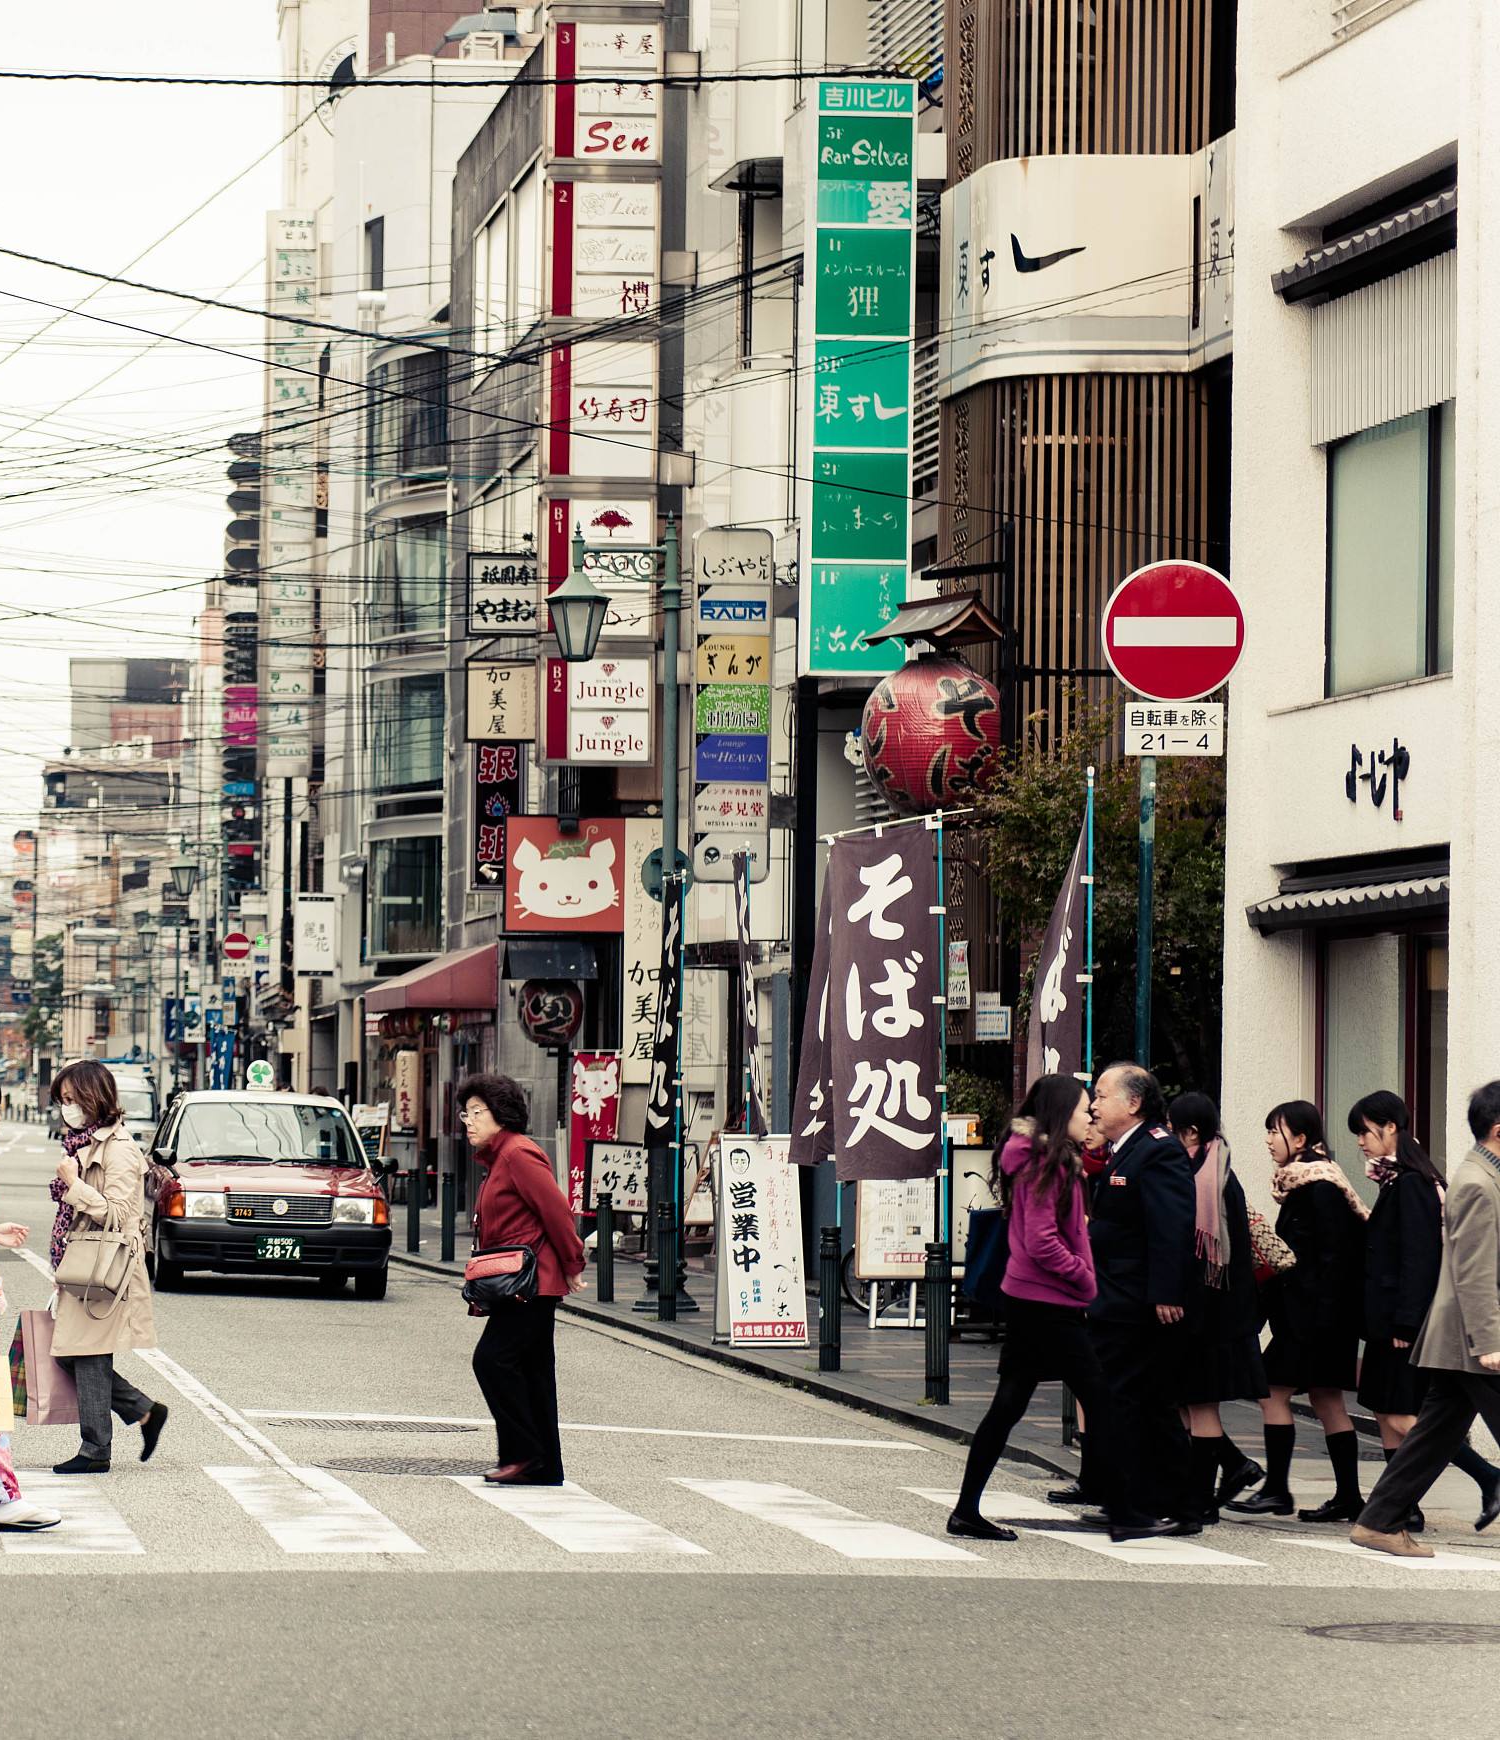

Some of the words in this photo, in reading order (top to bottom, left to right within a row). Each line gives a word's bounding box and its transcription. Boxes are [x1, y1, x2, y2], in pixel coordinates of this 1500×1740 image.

[825, 87, 905, 109] 吉川ビル
[584, 121, 650, 152] Sen
[821, 146, 850, 165] Bar
[852, 139, 909, 166] Silva
[559, 190, 568, 202] 2
[867, 181, 911, 224] 愛
[848, 286, 879, 317] 狸
[579, 397, 647, 422] 竹寿司
[816, 383, 907, 423] 東すし
[703, 556, 757, 578] しぶや
[701, 608, 766, 620] RAUM
[707, 653, 762, 677] ぎんが
[486, 667, 510, 734] 加美屋
[577, 681, 645, 704] Jungle
[707, 711, 759, 728] 動物園
[1131, 709, 1217, 727] 自転車を除く
[576, 733, 643, 756] Jungle
[718, 752, 763, 762] HEAVEN
[720, 801, 764, 817] 夢見堂
[845, 854, 936, 1150] そば処
[235, 1208, 252, 1217] 3743
[729, 1181, 761, 1273] 営業中
[265, 1245, 300, 1259] 28-74
